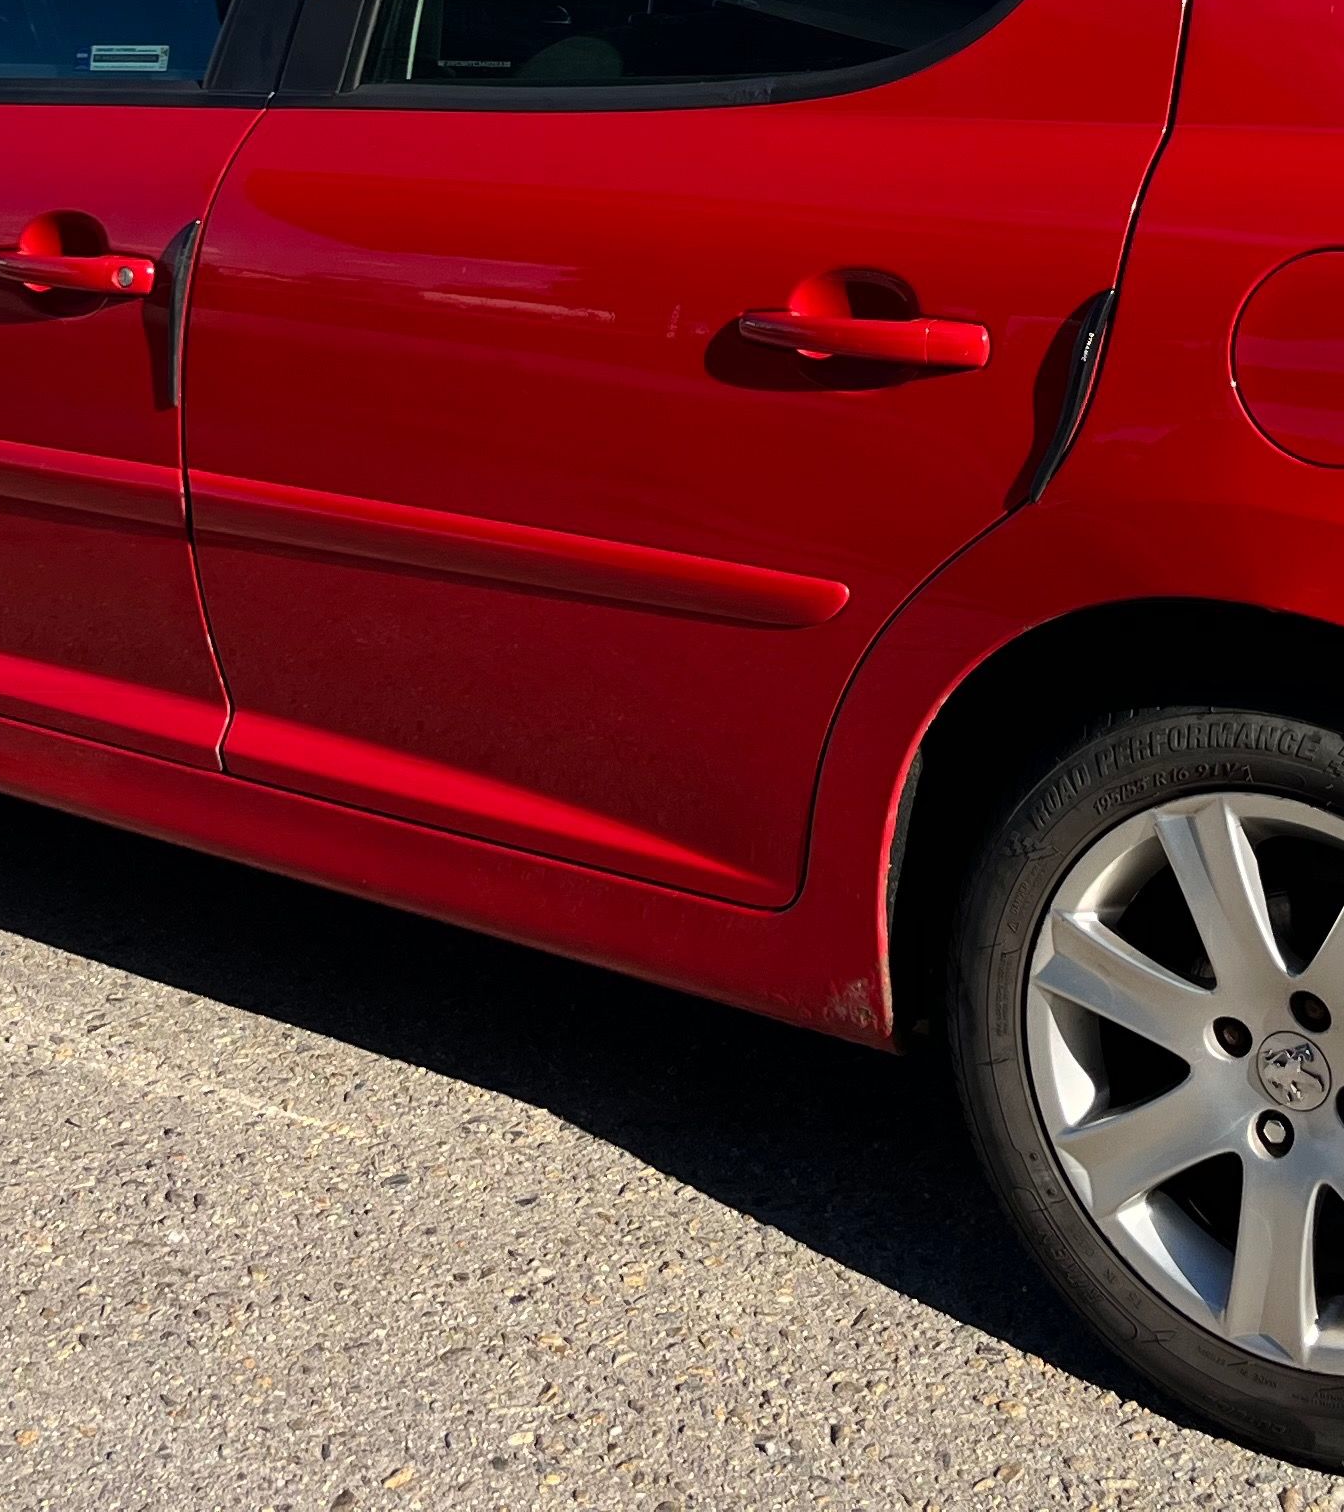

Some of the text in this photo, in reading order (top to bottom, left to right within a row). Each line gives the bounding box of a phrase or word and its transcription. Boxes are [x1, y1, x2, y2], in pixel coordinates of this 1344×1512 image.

[1032, 722, 1322, 832] ROAD PERFORMANCE
[1092, 774, 1149, 816] 195/55
